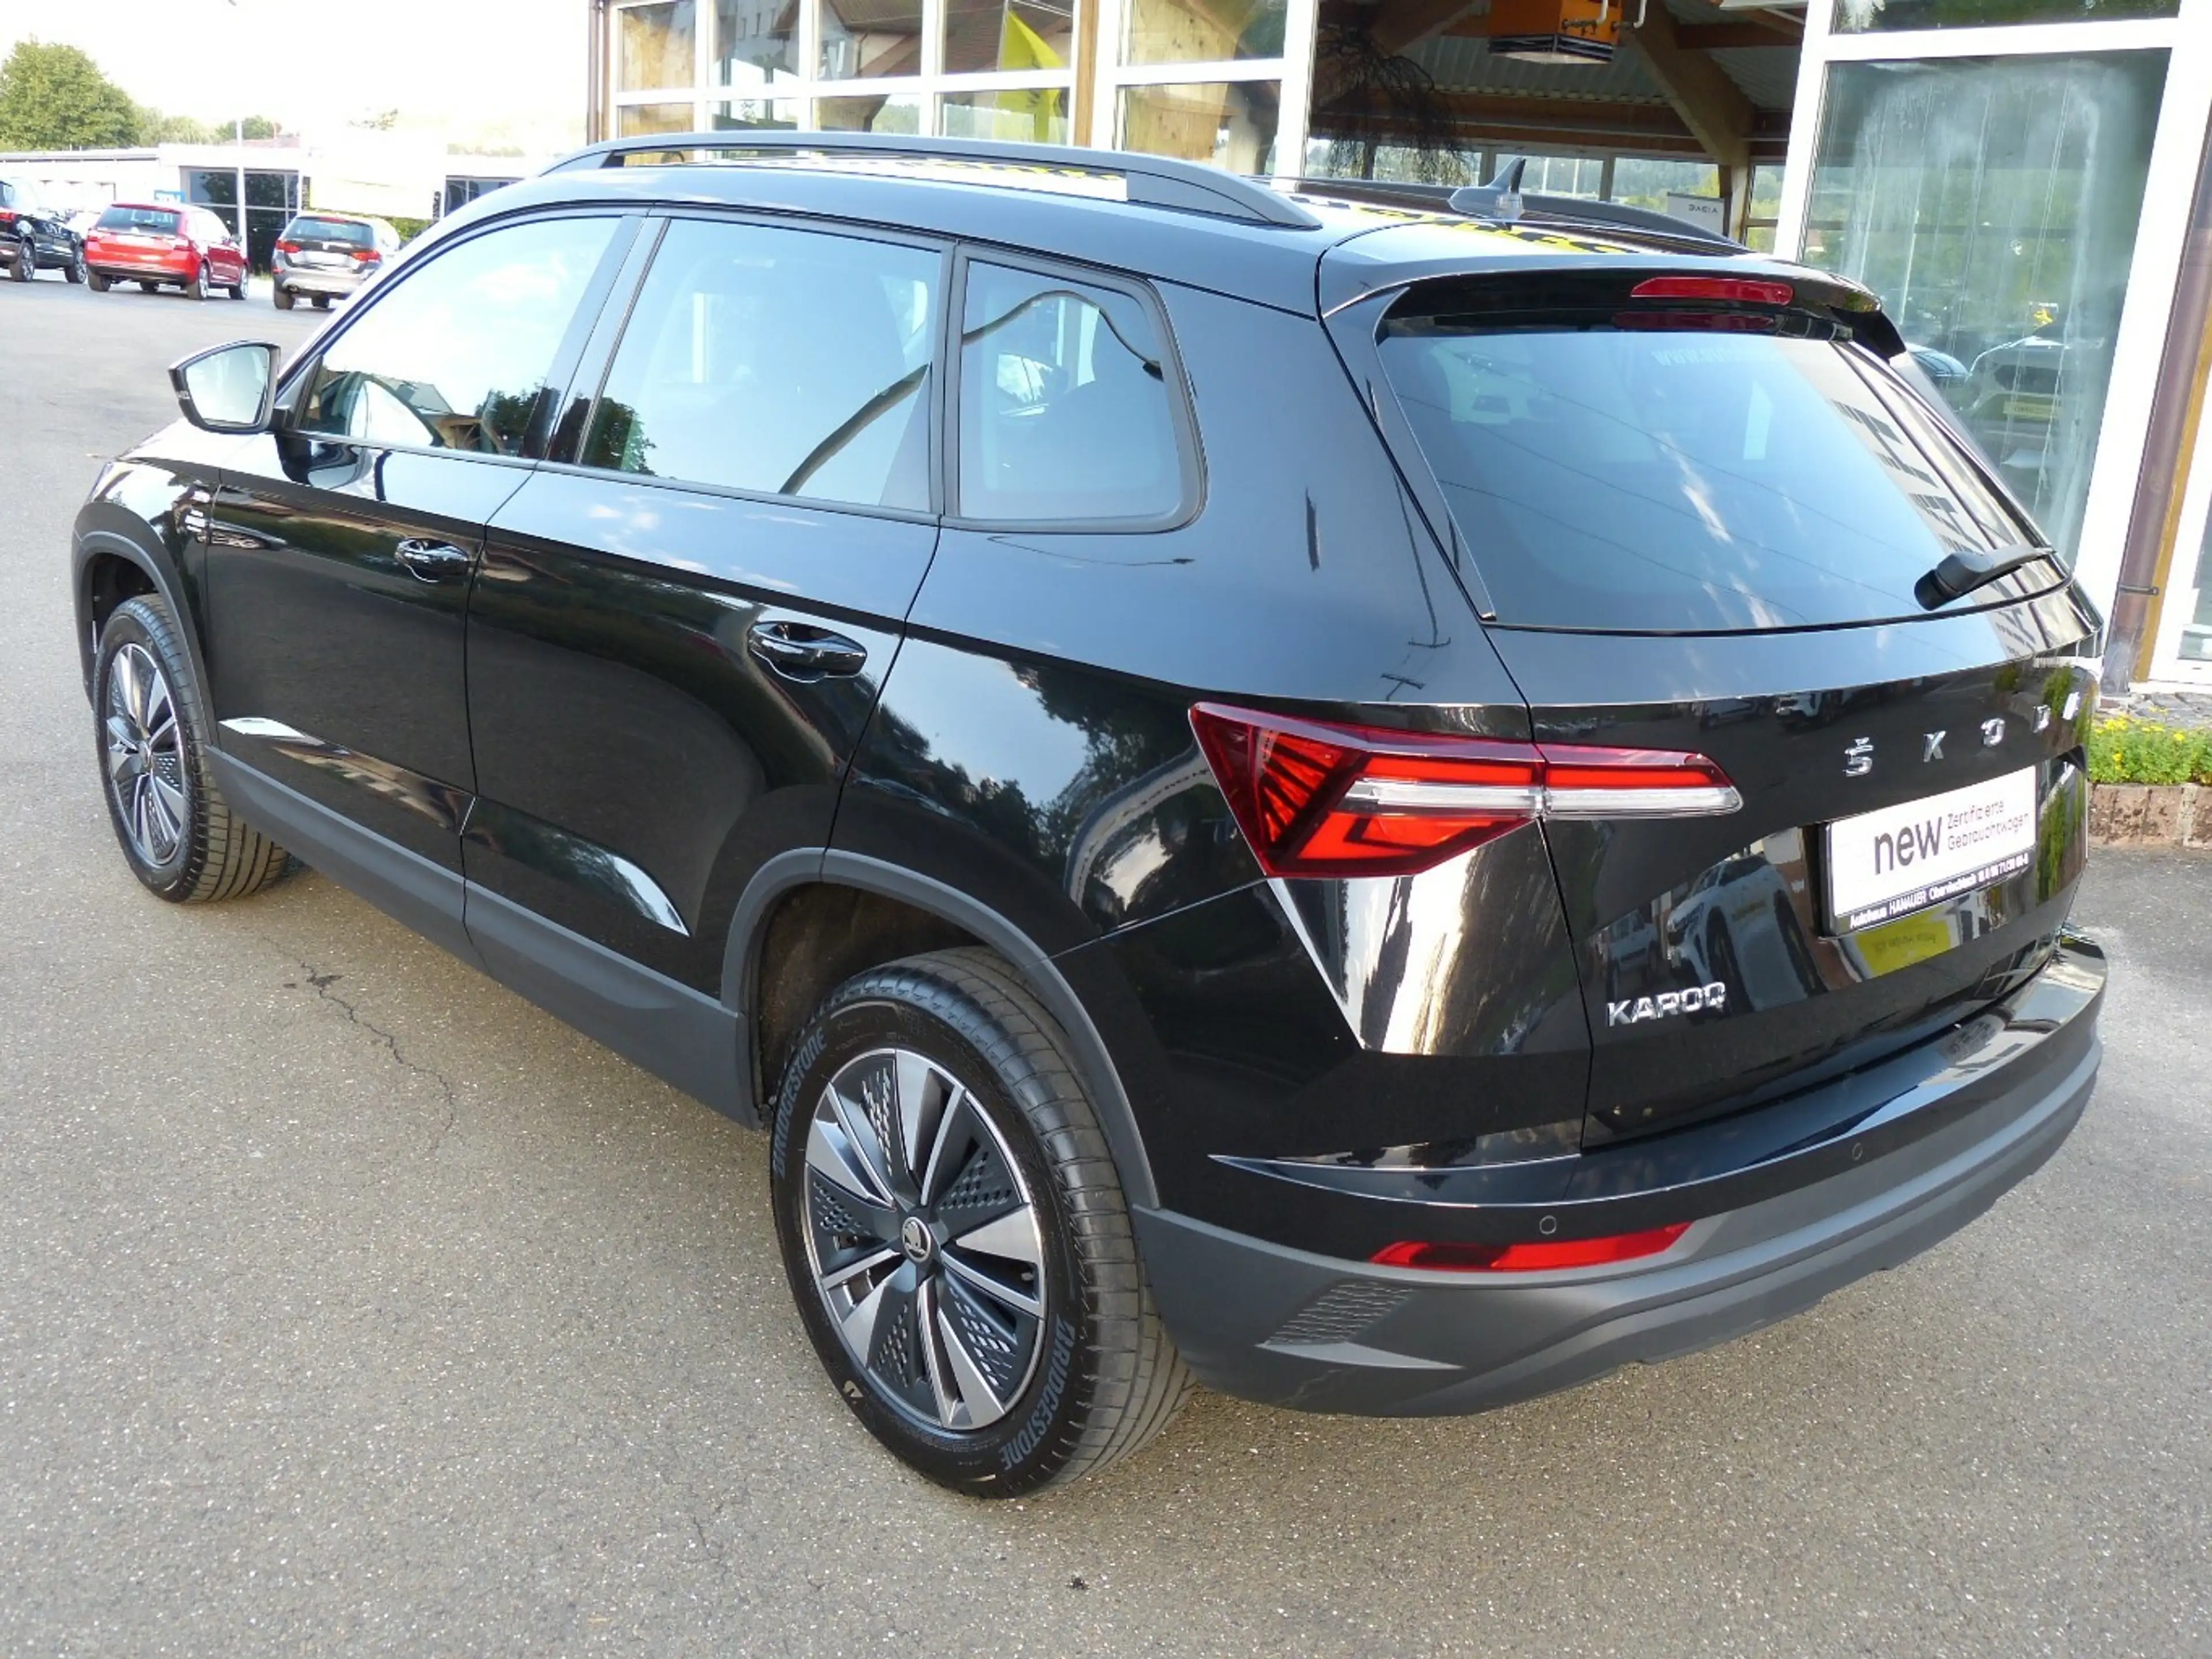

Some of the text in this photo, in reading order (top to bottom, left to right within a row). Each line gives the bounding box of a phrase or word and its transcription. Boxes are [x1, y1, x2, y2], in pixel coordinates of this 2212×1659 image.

[1875, 816, 1942, 875] new
[1607, 982, 1726, 1027] KAROQ
[773, 1027, 827, 1179] BRIDGESTONE
[999, 1314, 1075, 1471] BRIDGESTONE
